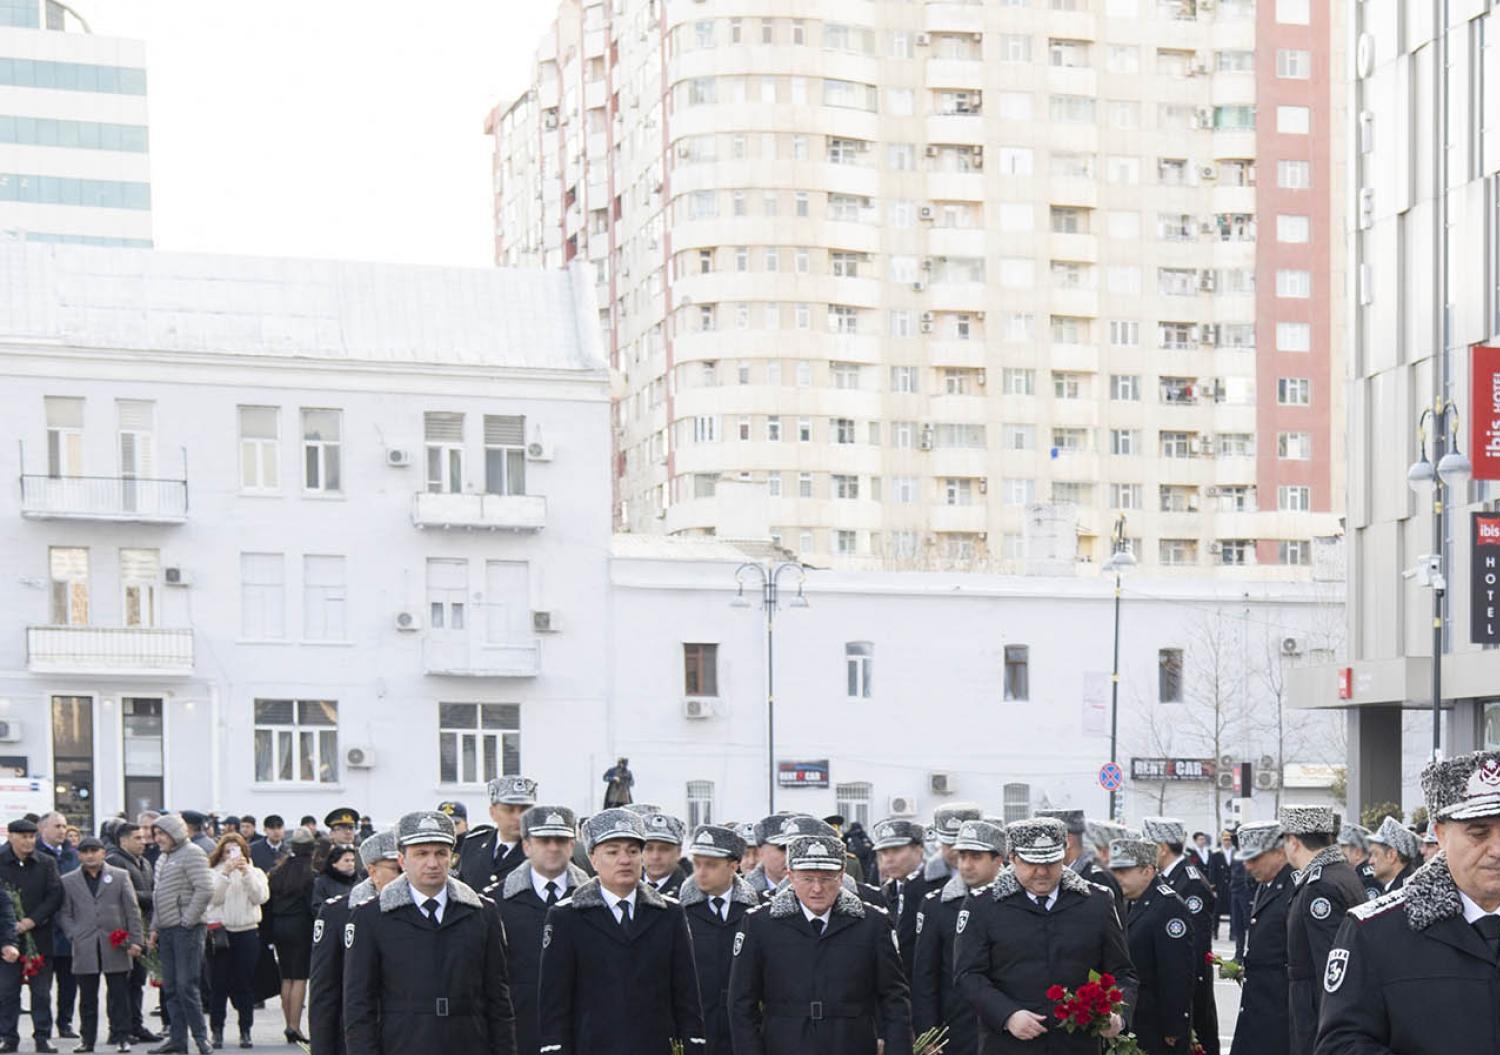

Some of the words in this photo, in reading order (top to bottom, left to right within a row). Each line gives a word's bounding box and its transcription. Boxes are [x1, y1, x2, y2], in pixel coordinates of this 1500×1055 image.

[1479, 524, 1500, 537] ibis
[1485, 556, 1496, 635] HOTEL
[1175, 760, 1203, 776] CAR
